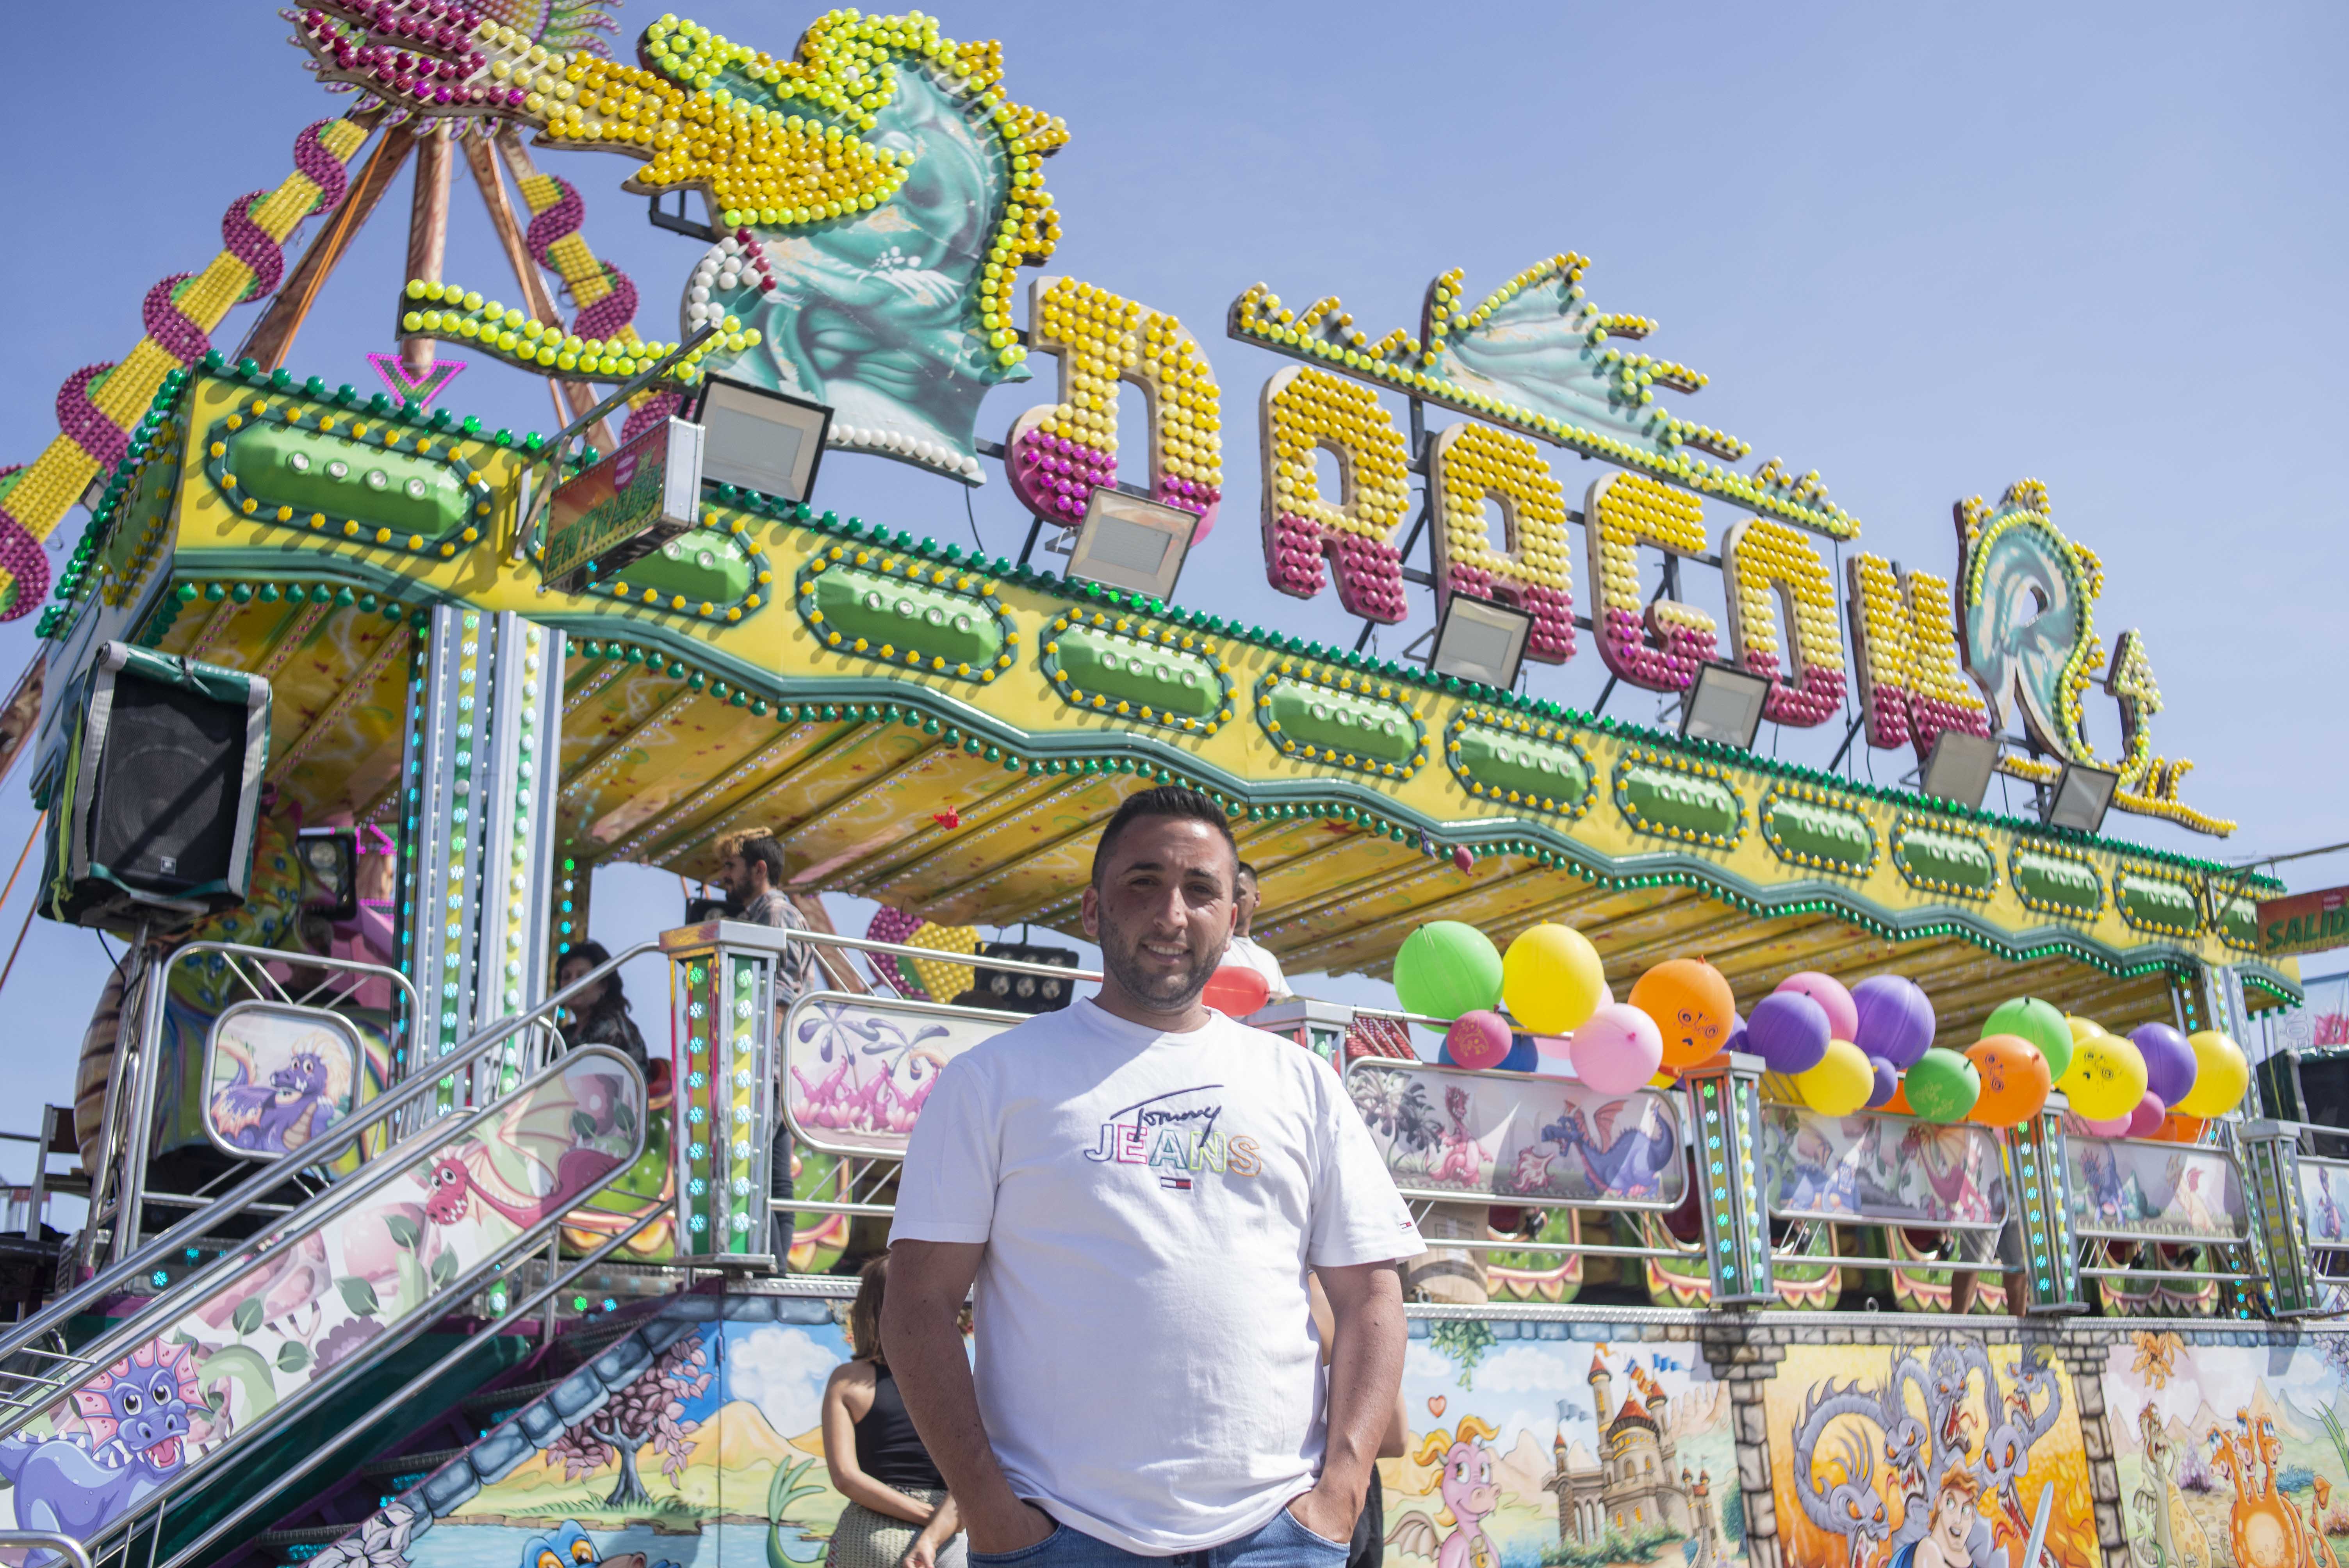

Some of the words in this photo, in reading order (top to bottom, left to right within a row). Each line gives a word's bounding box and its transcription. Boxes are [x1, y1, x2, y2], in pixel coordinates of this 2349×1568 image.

[547, 463, 661, 572] ENTRADA
[1005, 276, 1991, 759] DRAGON
[1084, 1124, 1262, 1176] JEANS
[1110, 1084, 1224, 1147] Tommy
